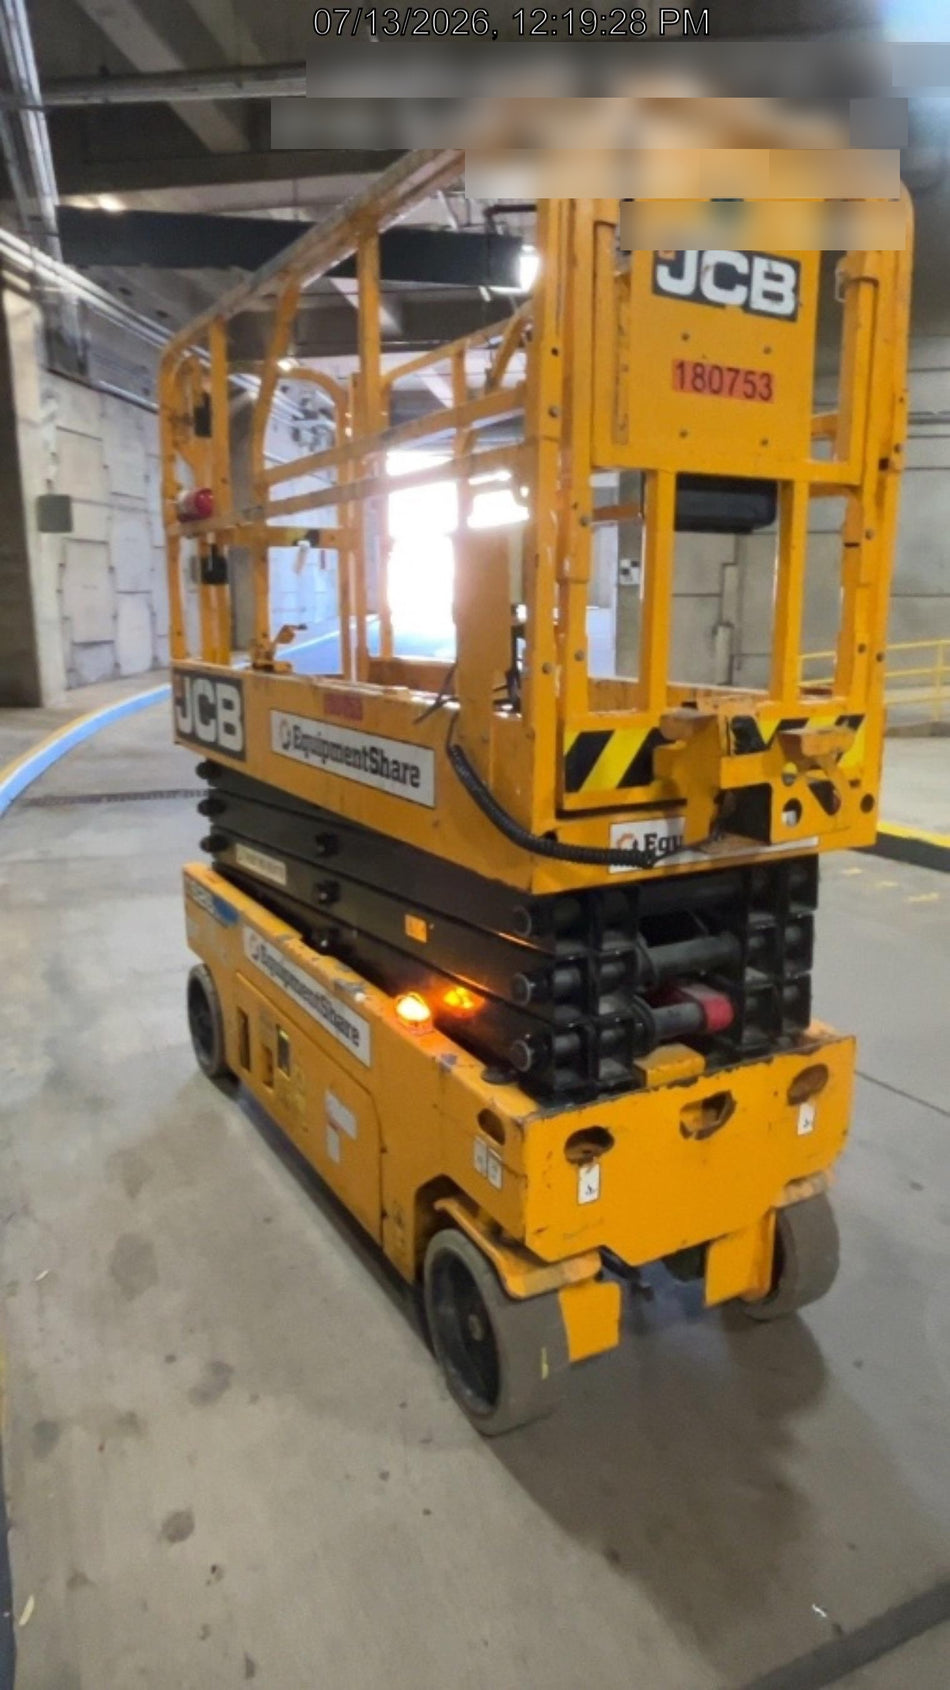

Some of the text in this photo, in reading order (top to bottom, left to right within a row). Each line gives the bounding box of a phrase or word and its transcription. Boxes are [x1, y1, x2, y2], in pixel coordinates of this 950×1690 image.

[656, 250, 797, 316] JCB
[673, 360, 774, 402] 180753
[175, 675, 244, 753] JCB
[292, 724, 421, 788] EquipmentShare
